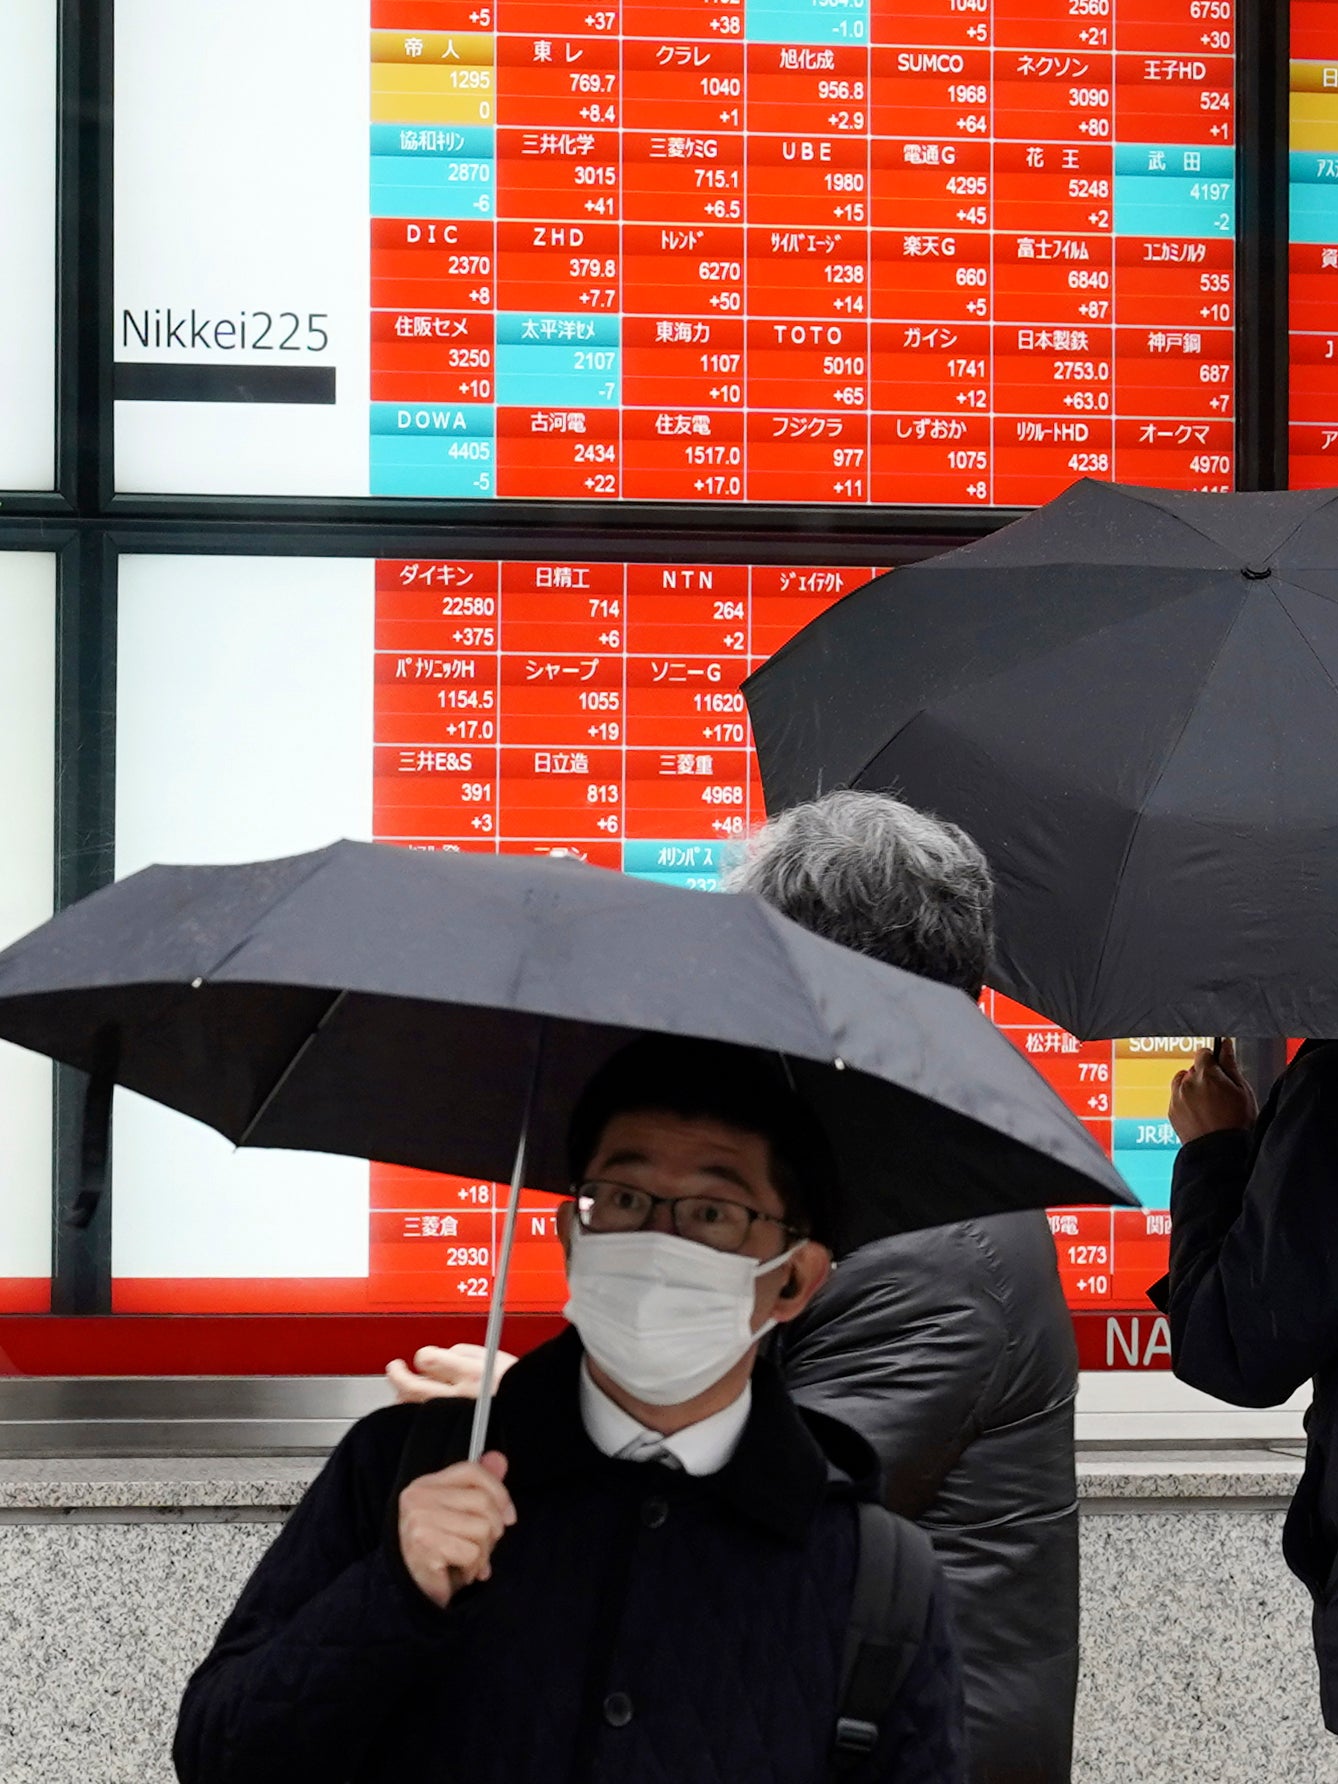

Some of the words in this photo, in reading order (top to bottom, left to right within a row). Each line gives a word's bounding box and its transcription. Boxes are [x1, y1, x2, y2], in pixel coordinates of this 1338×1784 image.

[1069, 0, 1109, 15] 2560
[1191, 1, 1230, 19] 6750
[1079, 27, 1106, 45] +21
[657, 46, 710, 66] クラレ
[780, 48, 834, 69] 旭化成
[898, 54, 963, 72] SUMCO
[1017, 56, 1088, 77] ネクソン
[1144, 60, 1206, 80] 王子HD
[450, 71, 491, 88] 1295
[570, 74, 615, 92] 769.7
[948, 85, 987, 103] 1968
[1201, 92, 1229, 110] 524
[580, 104, 615, 122] +8.4
[522, 134, 594, 155] 三井化学
[904, 144, 955, 164] 電通G
[448, 164, 490, 181] 2870
[575, 166, 616, 185] 3015
[1190, 184, 1229, 200] 4197
[904, 236, 955, 256] 楽天G
[570, 259, 615, 277] 379.8
[122, 309, 329, 352] Nikkei225
[904, 328, 957, 347] ガイシ
[1019, 330, 1088, 350] 日本製鉄
[1054, 361, 1108, 380] 2753.0
[1064, 392, 1108, 410] +63.0
[531, 412, 586, 433] 古河電
[656, 414, 711, 435] 住友電
[773, 417, 842, 436] フジクラ
[897, 418, 966, 439] しずおか
[1140, 424, 1209, 443] オークマ
[448, 442, 490, 460] 4405
[686, 446, 740, 464] 1517.0
[694, 477, 740, 494] +17.0
[400, 564, 473, 585] ダイキン
[536, 567, 589, 588] 日精工
[443, 597, 494, 615] 22580
[589, 599, 619, 617] 714
[714, 602, 744, 619] 264
[453, 628, 494, 646] +375
[599, 630, 620, 648] +6
[724, 632, 744, 650] +2
[526, 658, 599, 680] シャープ
[652, 662, 720, 681] ソニーG
[439, 690, 493, 708] 1154.5
[579, 692, 619, 710] 1055
[694, 694, 744, 712] 11620
[447, 721, 493, 738] +17.0
[703, 724, 743, 742] +170
[399, 751, 472, 771] 三井E&S
[535, 753, 588, 773] 日立造
[660, 754, 713, 774] 三菱重
[462, 783, 490, 801] 391
[587, 785, 618, 802] 813
[702, 786, 743, 804] 4968
[472, 814, 492, 831] +3
[597, 815, 618, 833] +6
[1026, 1032, 1079, 1053] 松井証
[1129, 1037, 1213, 1052] SOMPOH
[1078, 1064, 1109, 1082] 776
[1089, 1094, 1107, 1111] +3
[1136, 1126, 1181, 1144] JR東
[458, 1185, 489, 1203] +18
[404, 1216, 458, 1236] 三菱倉
[447, 1248, 488, 1265] 2930
[1069, 1246, 1107, 1264] 1273
[457, 1278, 488, 1296] +22
[1077, 1276, 1107, 1293] +10
